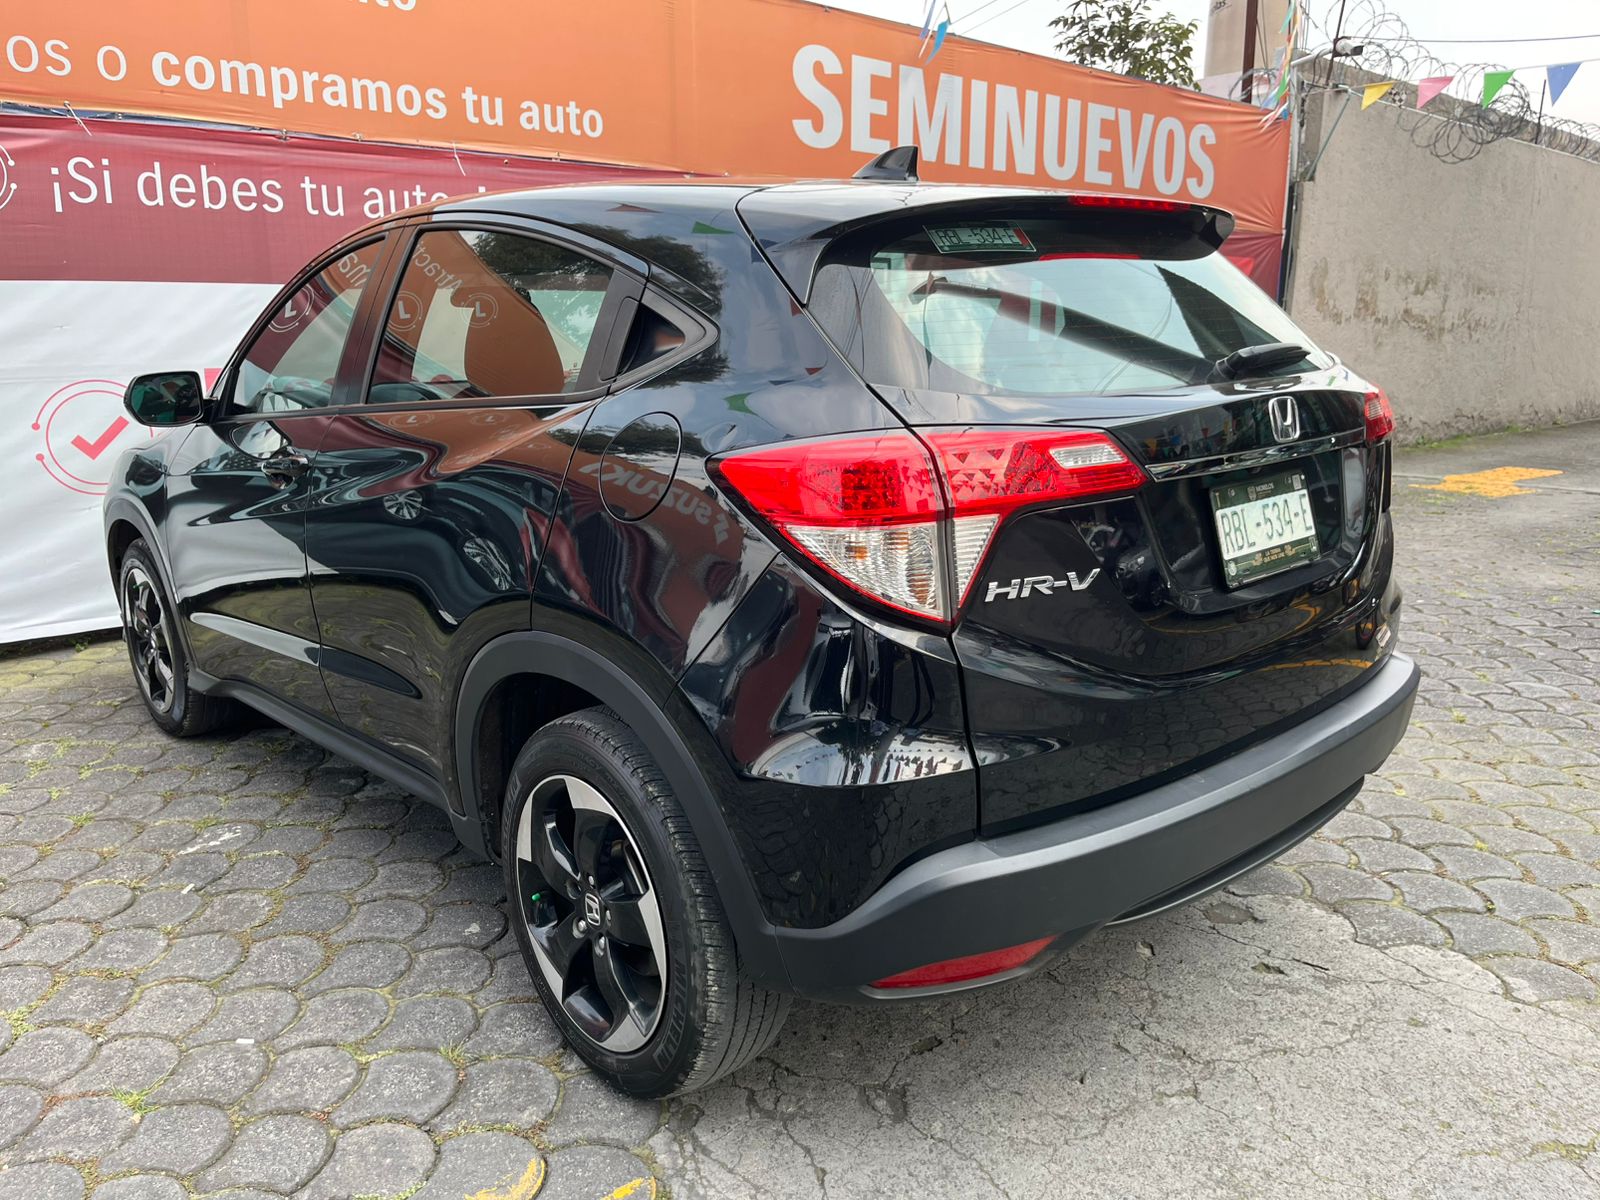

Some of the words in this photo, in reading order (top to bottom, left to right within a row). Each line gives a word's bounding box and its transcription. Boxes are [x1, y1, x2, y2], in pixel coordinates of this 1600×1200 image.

[96, 45, 127, 81] o
[151, 51, 448, 119] compramos
[461, 86, 504, 127] tu
[519, 100, 604, 138] auto
[791, 44, 1216, 199] SEMINUEVOS
[50, 156, 113, 213] ¡Si
[136, 161, 285, 213] debes
[300, 175, 345, 217] tu
[1220, 493, 1313, 554] RBL-534-E
[984, 567, 1101, 603] HR-V
